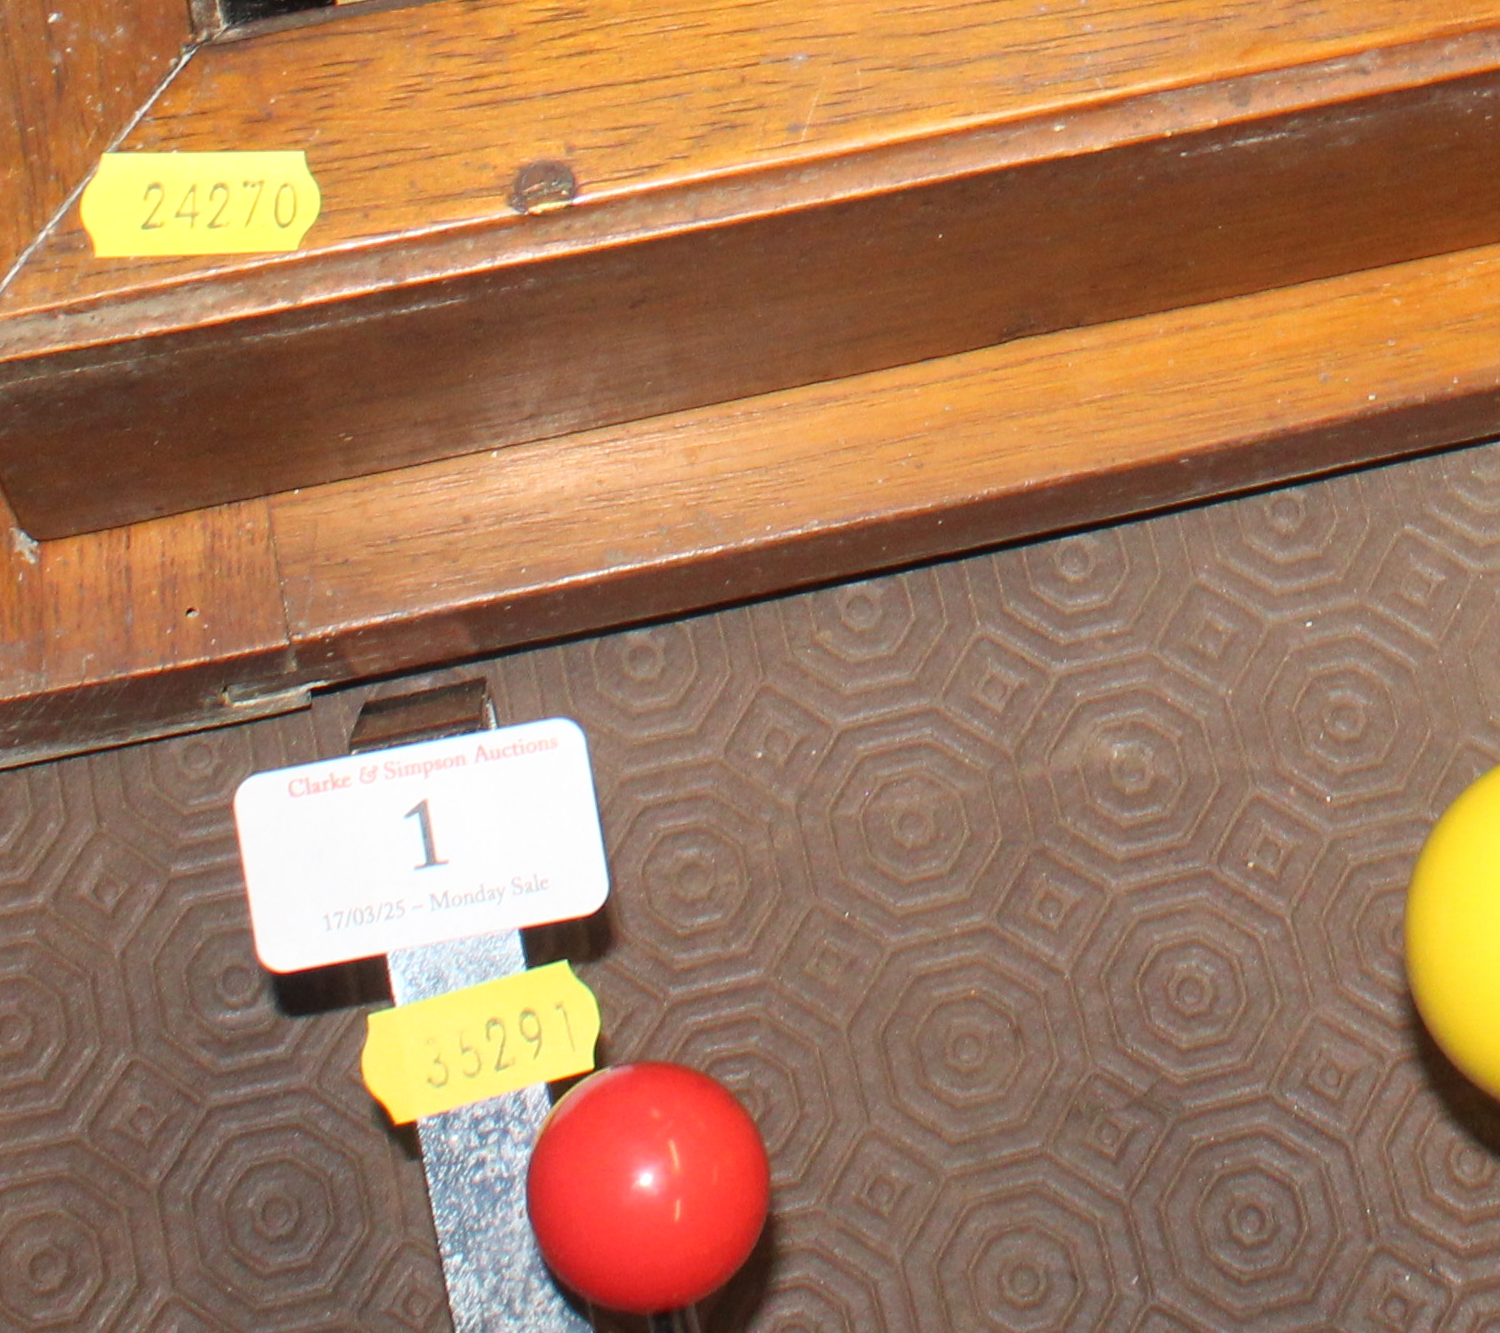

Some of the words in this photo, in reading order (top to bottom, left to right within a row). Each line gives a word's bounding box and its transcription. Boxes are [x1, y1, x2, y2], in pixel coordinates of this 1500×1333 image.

[140, 180, 298, 230] 24270
[286, 774, 353, 799] Clarke
[358, 764, 380, 784] &
[383, 752, 468, 784] Simpson
[473, 735, 560, 764] Auctions
[402, 797, 450, 872] 1
[322, 899, 407, 933] 17/03/25
[428, 883, 507, 914] Monday
[511, 875, 551, 895] Sale
[425, 1001, 577, 1091] 35291
